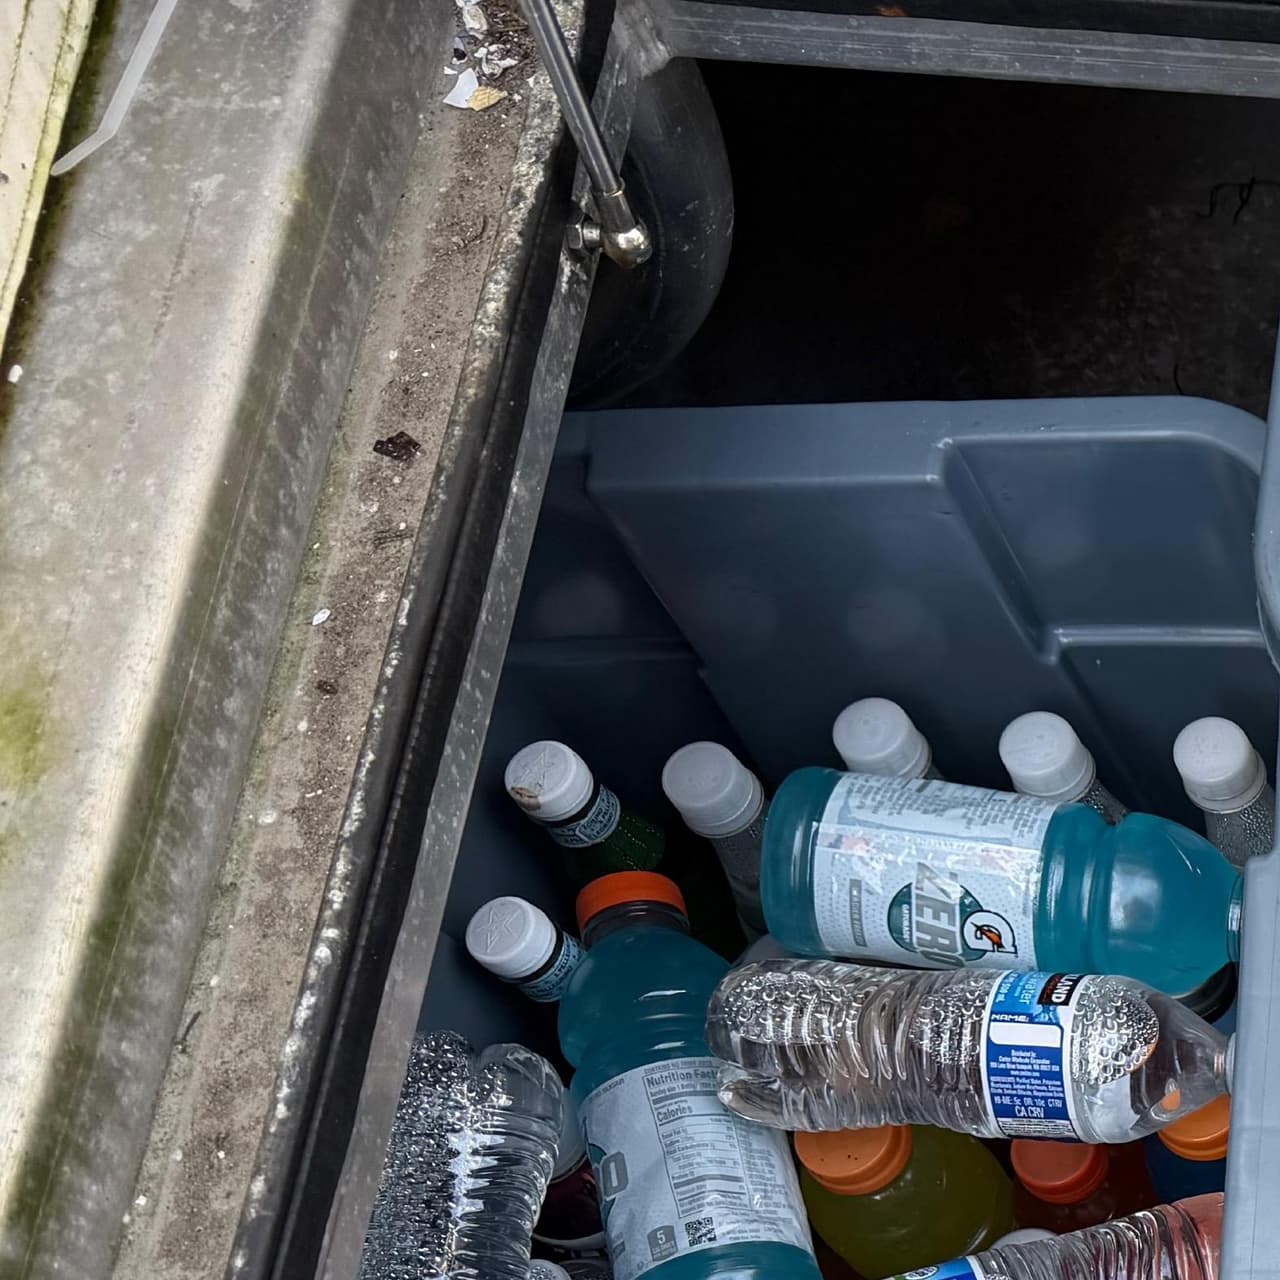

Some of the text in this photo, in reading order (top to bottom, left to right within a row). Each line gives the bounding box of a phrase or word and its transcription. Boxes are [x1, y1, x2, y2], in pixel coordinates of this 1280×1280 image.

[911, 862, 966, 971] ZERO
[991, 1014, 1030, 1023] NAME:
[646, 1071, 693, 1087] Nutrition
[657, 1106, 693, 1121] Calories
[1015, 1106, 1044, 1118] CA CRV
[656, 1229, 666, 1243] 5
